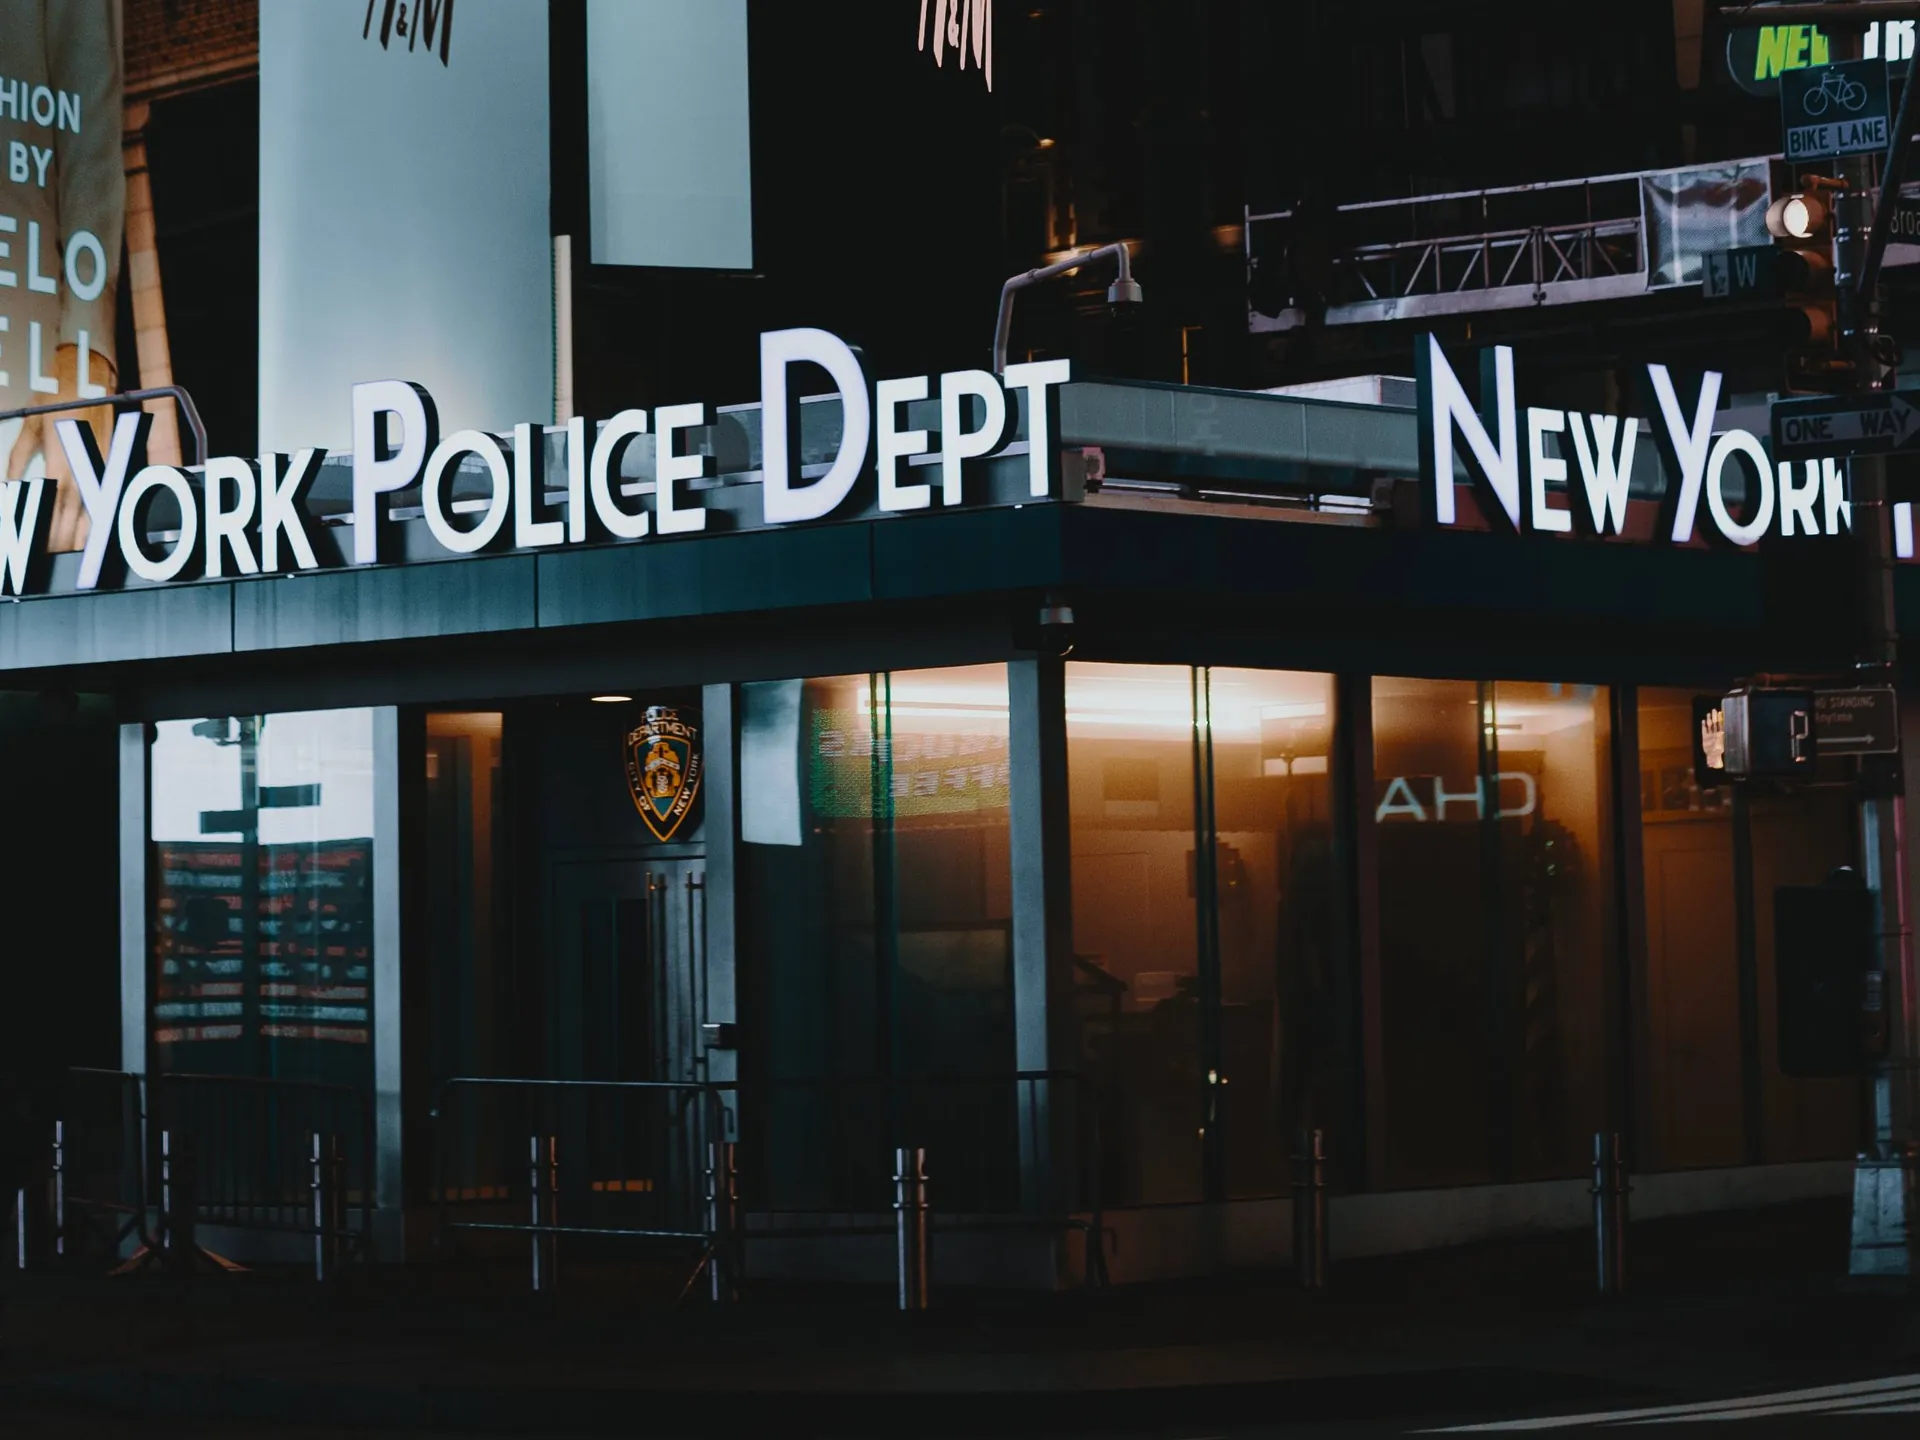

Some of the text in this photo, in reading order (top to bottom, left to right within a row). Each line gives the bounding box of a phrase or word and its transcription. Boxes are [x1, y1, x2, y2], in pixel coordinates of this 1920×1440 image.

[1790, 120, 1885, 153] BIKE LANE
[9, 141, 53, 188] BY
[1736, 254, 1757, 289] W
[1430, 332, 1639, 536] NEW
[1786, 408, 1911, 442] ONE WAY
[54, 411, 319, 593] YORK
[352, 380, 706, 565] POLICE
[761, 327, 1070, 524] DEPT
[628, 721, 698, 746] DEPARTMENT
[673, 787, 691, 816] NEW
